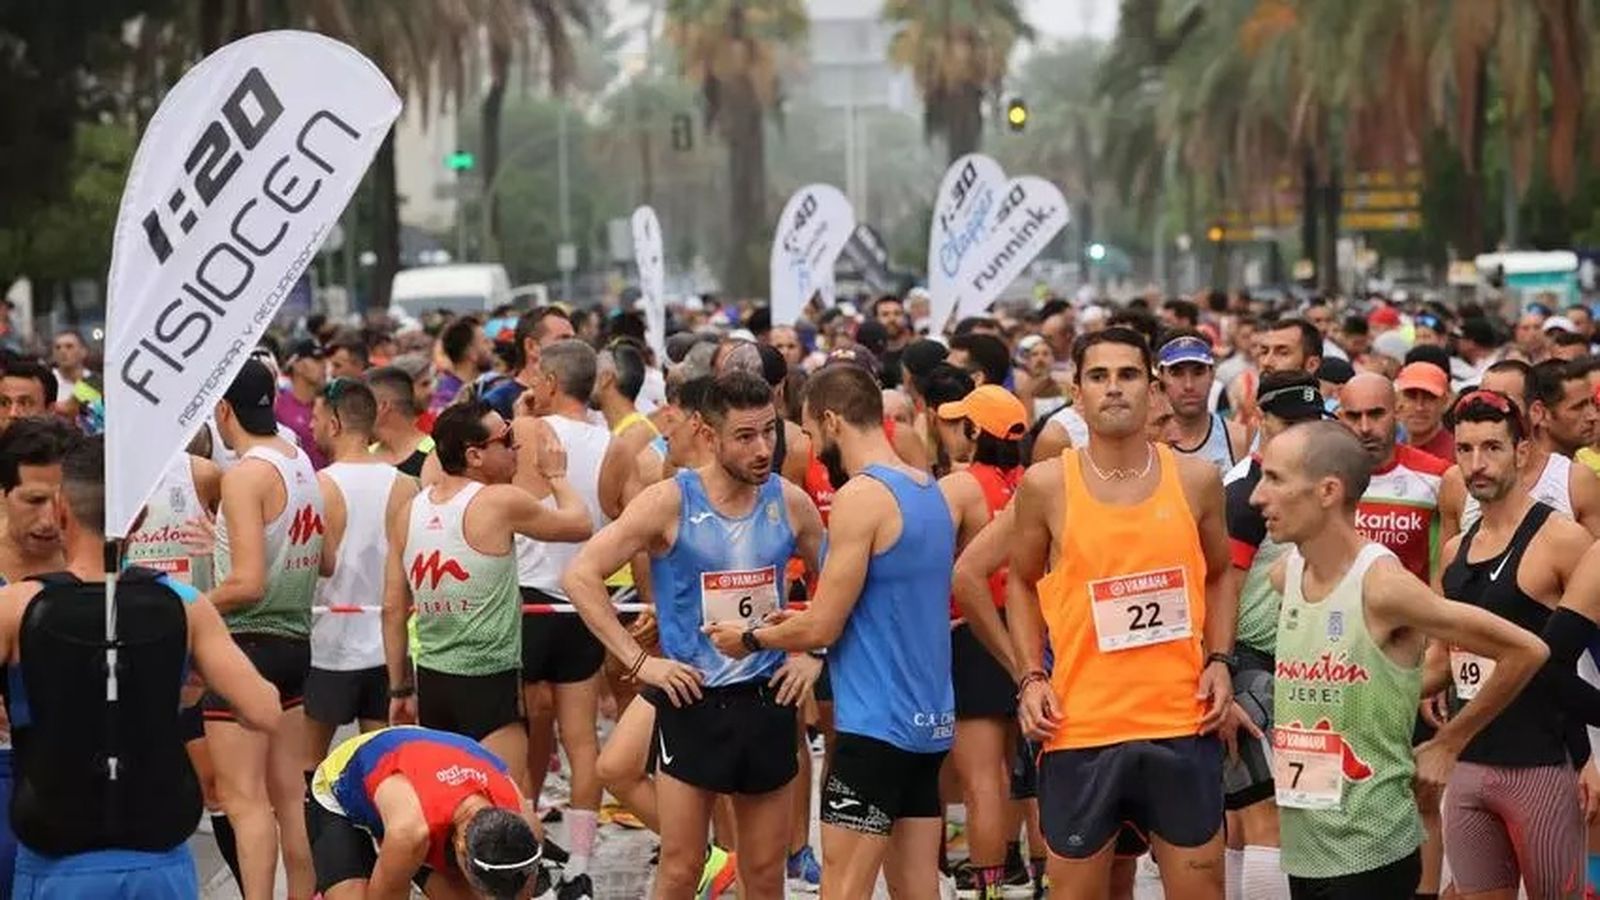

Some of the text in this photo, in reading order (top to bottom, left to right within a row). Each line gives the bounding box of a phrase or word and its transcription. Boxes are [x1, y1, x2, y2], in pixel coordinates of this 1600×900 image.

[142, 67, 285, 265] 1:20
[121, 110, 361, 405] FISIOCEN
[973, 206, 1056, 291] runnink.
[1124, 573, 1168, 592] YAMAHA
[738, 596, 752, 618] 6
[1126, 602, 1164, 631] 22
[1460, 662, 1481, 685] 49
[1287, 732, 1327, 752] YAMAHA
[1289, 762, 1304, 789] 7
